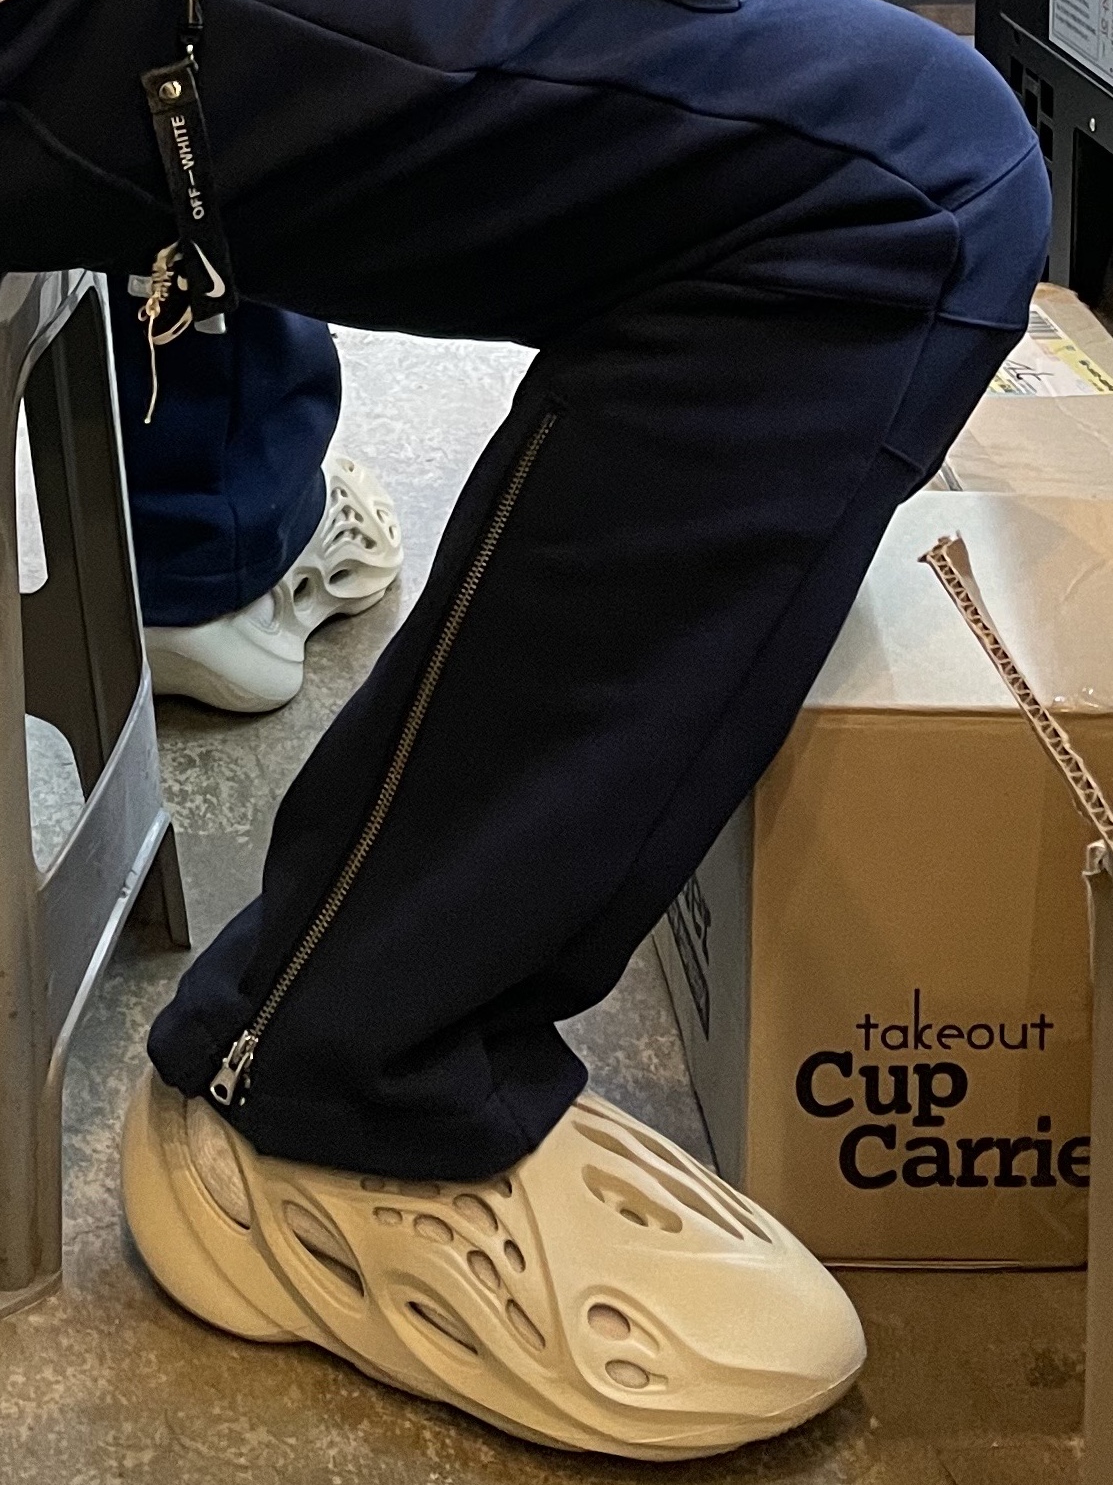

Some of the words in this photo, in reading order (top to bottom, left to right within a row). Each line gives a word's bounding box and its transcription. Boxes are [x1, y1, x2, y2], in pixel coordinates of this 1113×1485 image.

[856, 989, 1054, 1051] takeout
[795, 1051, 968, 1127] Cup
[839, 1116, 1091, 1189] Carrie
